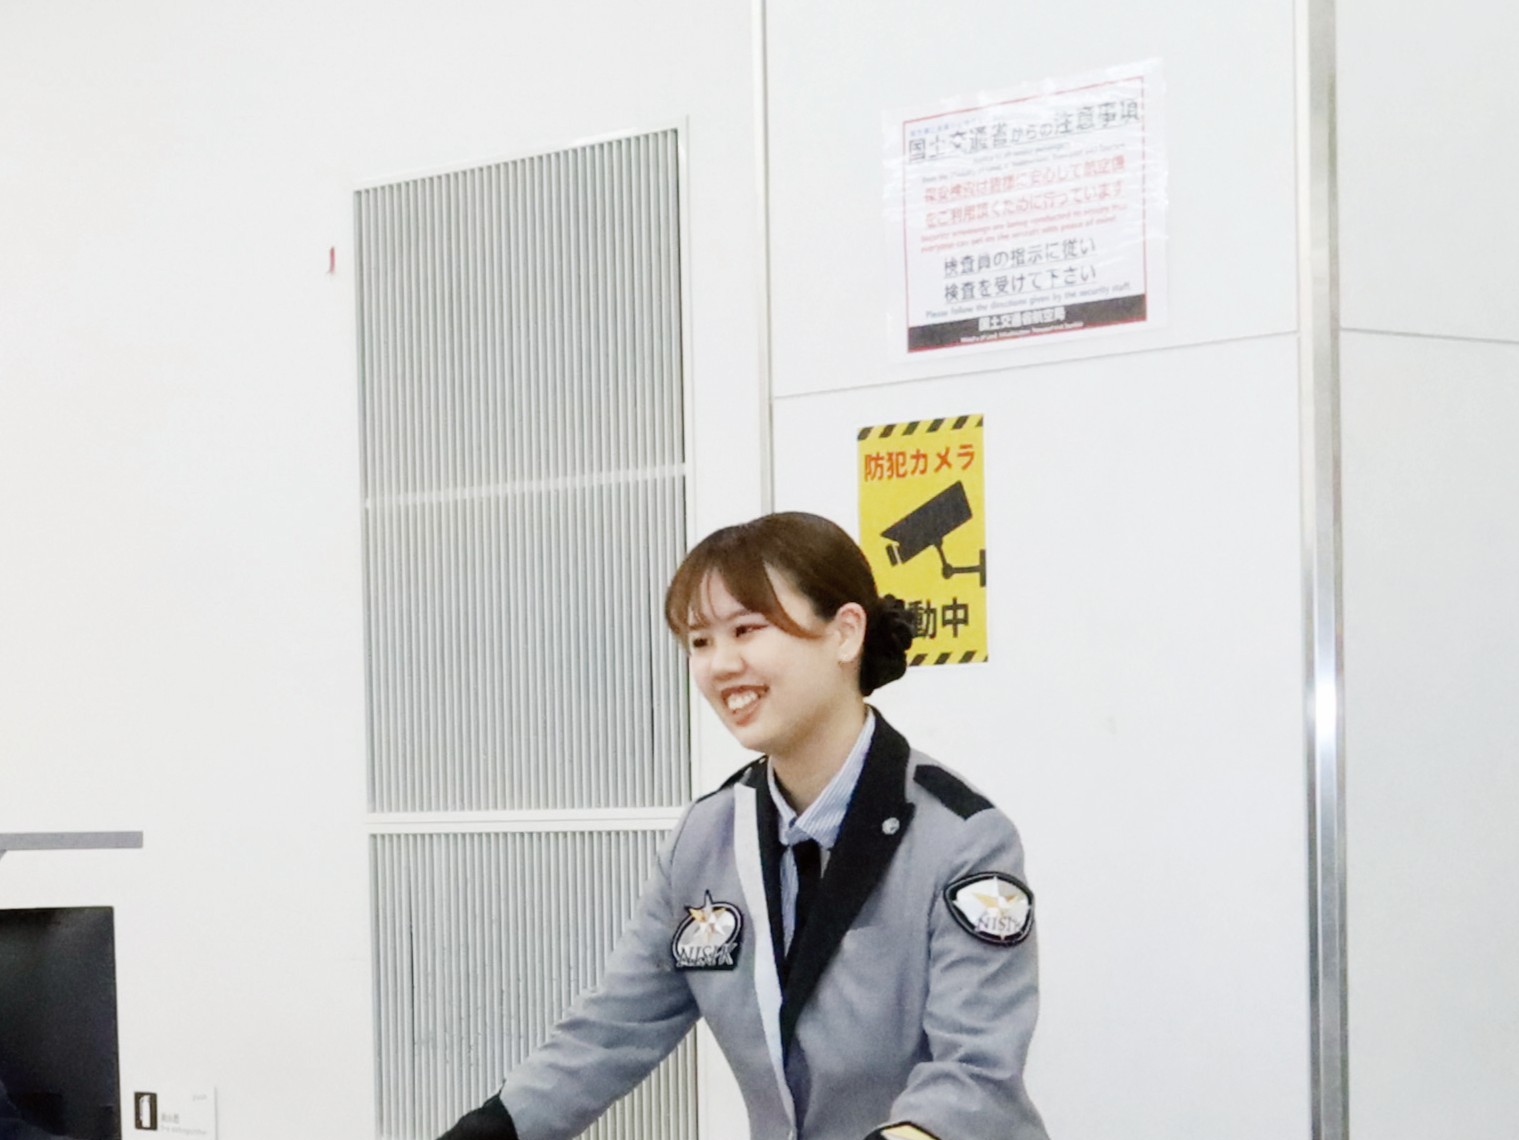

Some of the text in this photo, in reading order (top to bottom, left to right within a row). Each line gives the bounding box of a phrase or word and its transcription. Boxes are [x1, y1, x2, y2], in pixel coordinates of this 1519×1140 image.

[944, 238, 1096, 278] 検査員の指示に従い
[944, 265, 1096, 304] 検査を受けて下さい
[864, 444, 975, 482] 防犯カメラ
[907, 596, 969, 639] 動中
